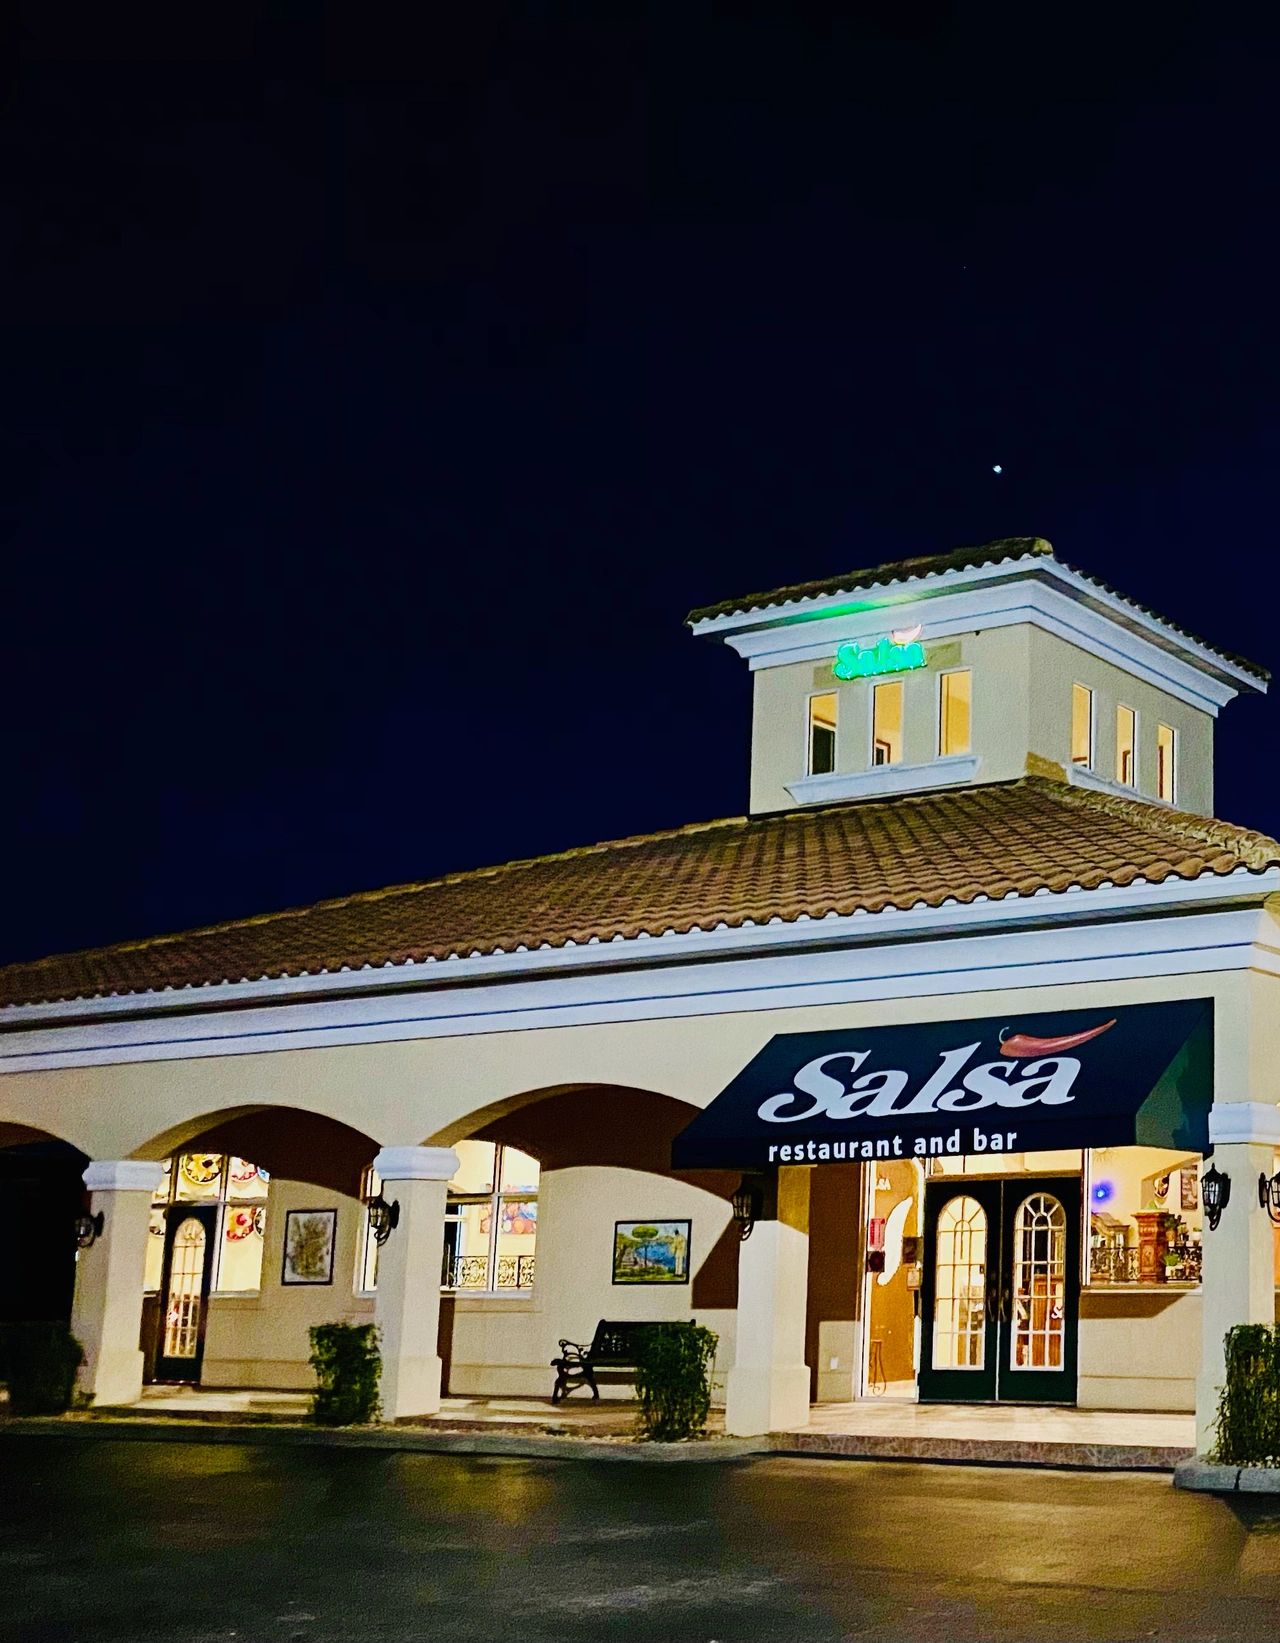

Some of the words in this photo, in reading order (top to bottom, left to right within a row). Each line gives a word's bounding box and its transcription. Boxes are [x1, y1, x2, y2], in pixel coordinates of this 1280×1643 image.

[757, 1041, 1082, 1123] Salsa
[768, 1135, 903, 1162] restaurant
[913, 1128, 961, 1155] and
[973, 1127, 1018, 1151] bar
